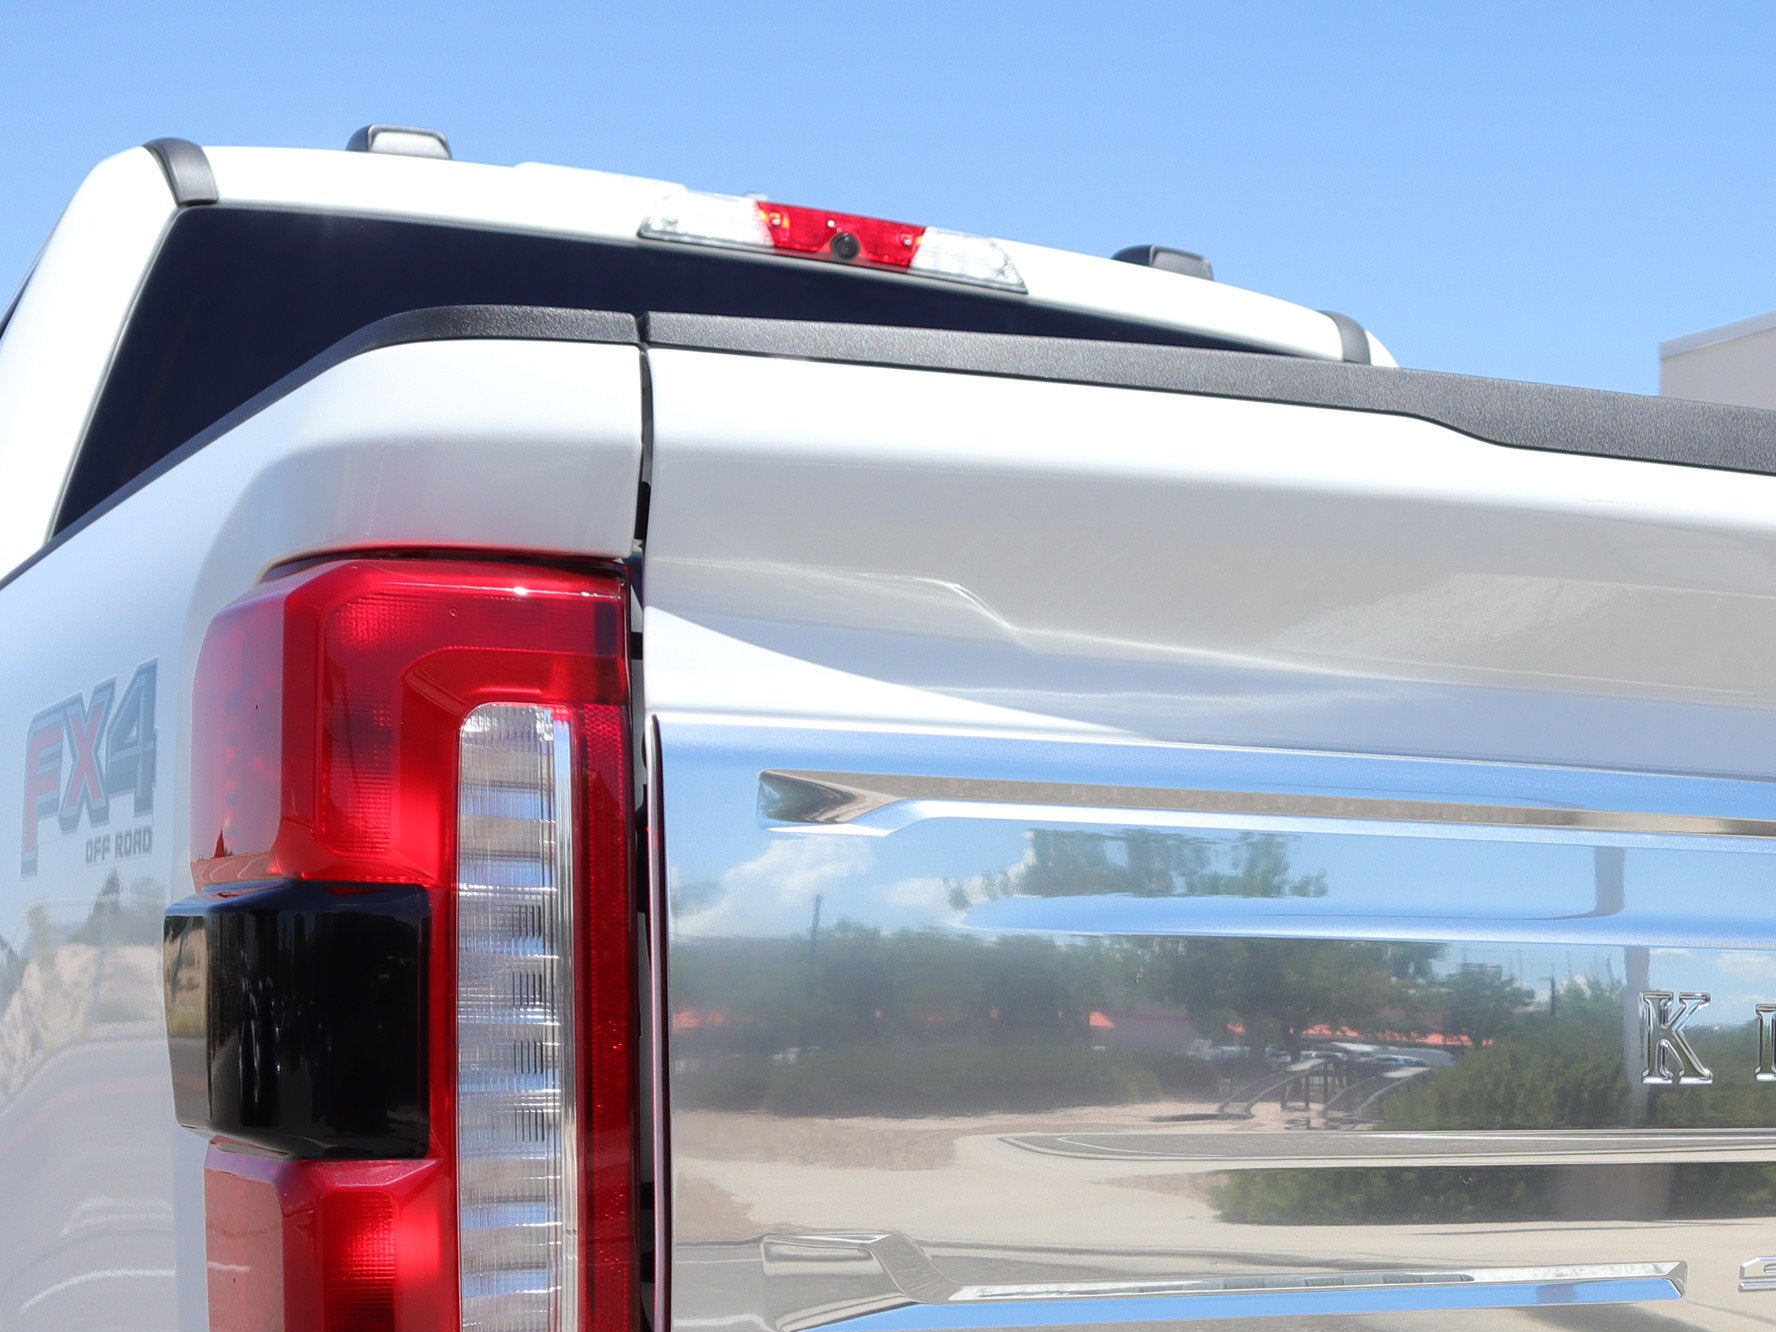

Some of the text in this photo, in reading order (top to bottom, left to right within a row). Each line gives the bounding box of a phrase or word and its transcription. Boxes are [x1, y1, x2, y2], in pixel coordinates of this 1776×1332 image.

[20, 655, 158, 878] FX4
[86, 826, 153, 864] OFF ROAD
